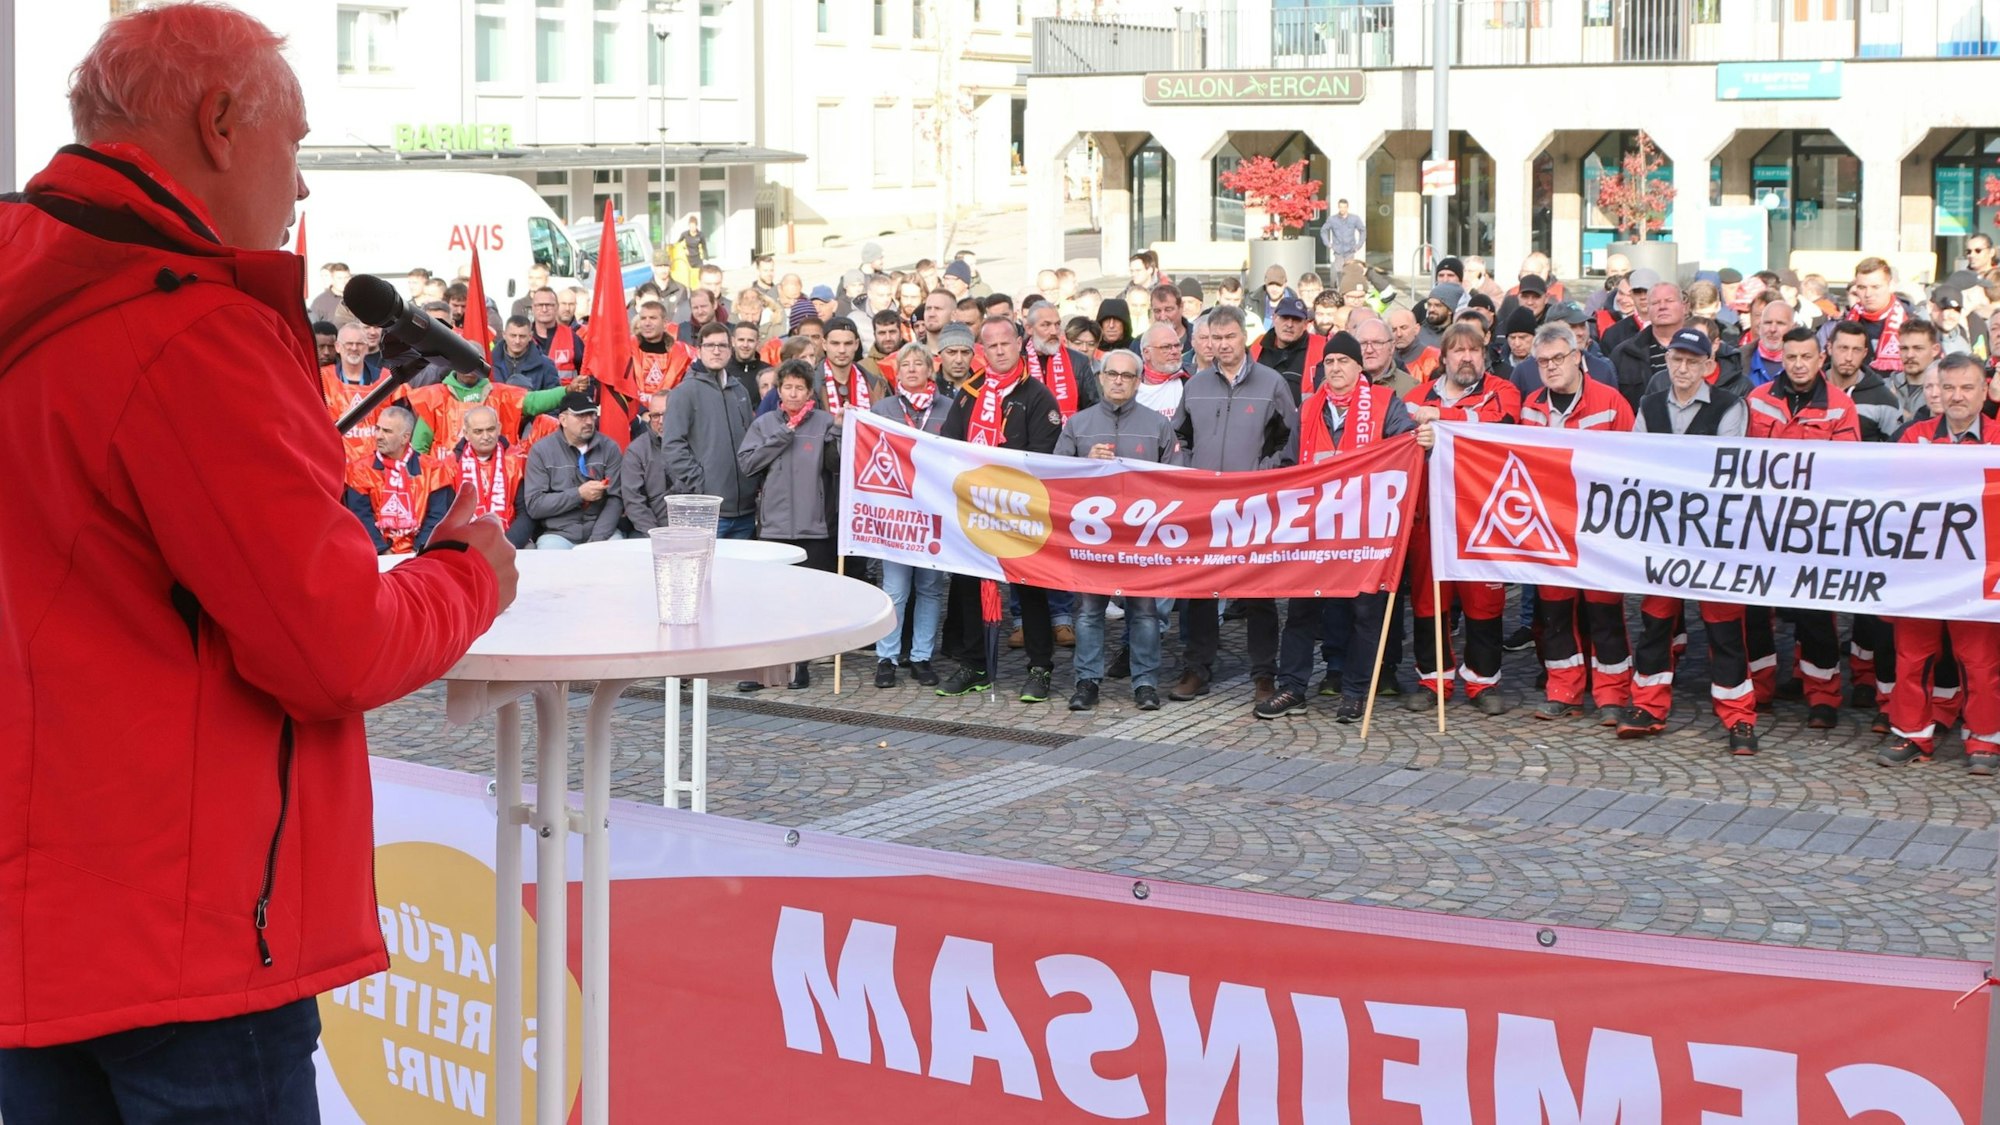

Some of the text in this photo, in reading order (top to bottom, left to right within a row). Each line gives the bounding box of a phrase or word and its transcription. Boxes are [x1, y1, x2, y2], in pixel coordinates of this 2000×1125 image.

[1157, 75, 1350, 99] SALON ERCAN
[395, 123, 513, 150] BARMER
[448, 224, 504, 251] AVIS
[1053, 351, 1069, 400] MITEIN
[1356, 385, 1372, 449] MORGE
[1709, 447, 1815, 490] AUCH
[853, 502, 929, 526] SOLIDARITÄT
[970, 485, 1032, 517] WIR
[1209, 470, 1408, 547] MEHR
[1581, 477, 1977, 561] DÖRRENBERGER
[905, 543, 925, 553] 2022
[1069, 548, 1115, 563] Höhere
[1118, 551, 1172, 567] Entgelte
[1645, 556, 1887, 602] WOLLEN MEHR
